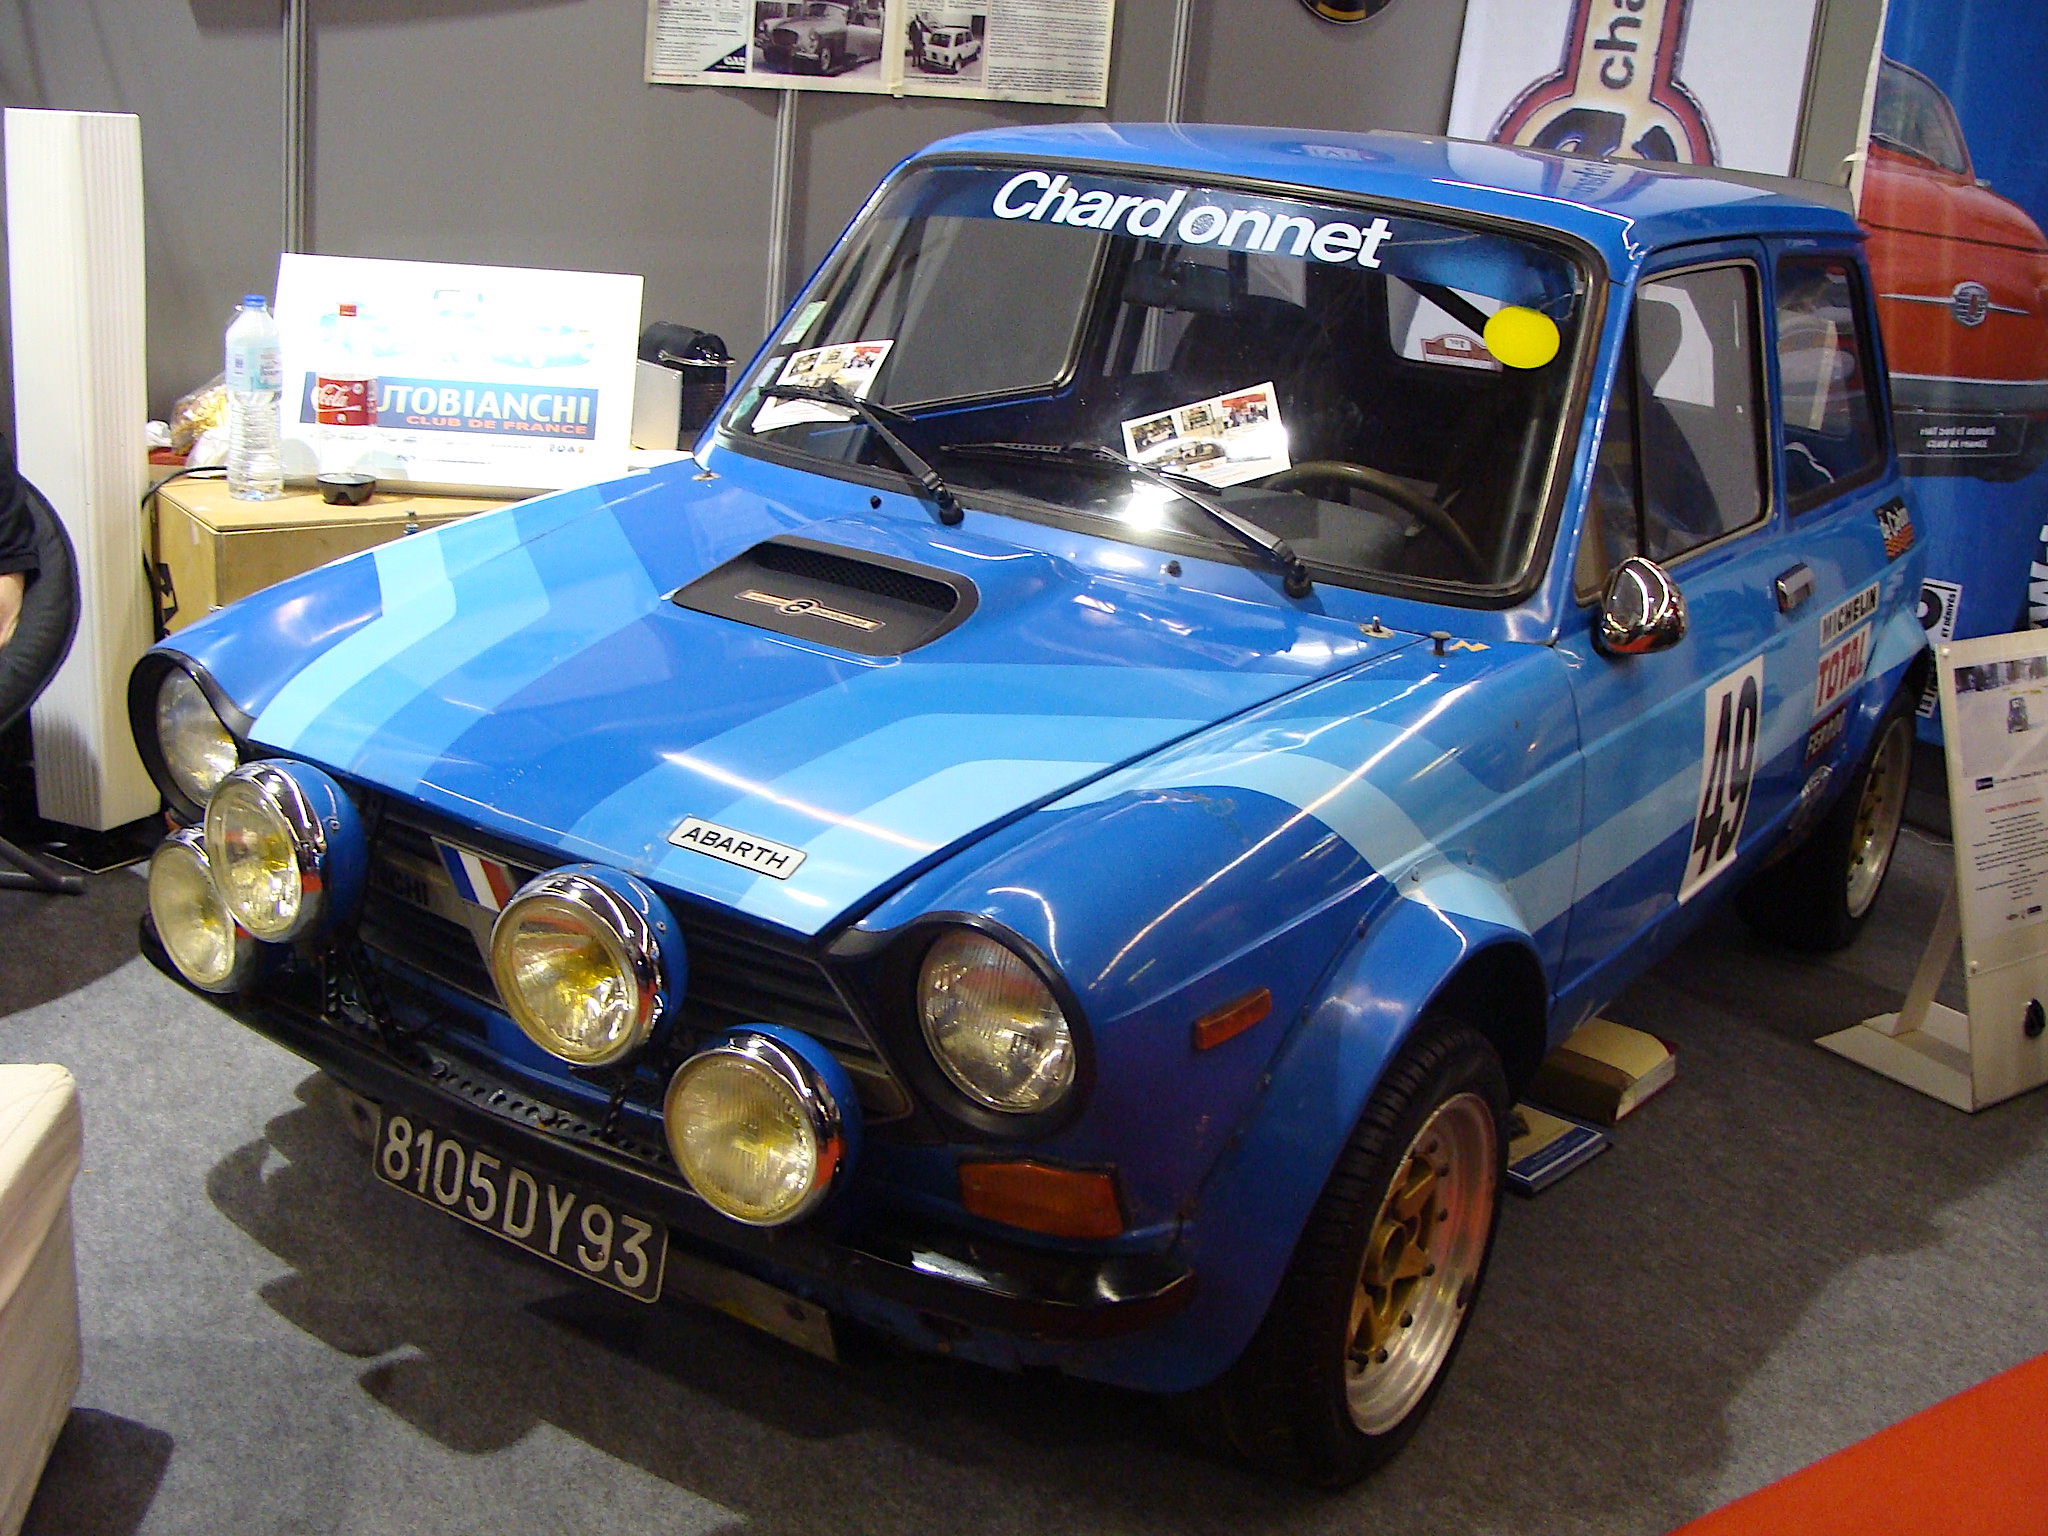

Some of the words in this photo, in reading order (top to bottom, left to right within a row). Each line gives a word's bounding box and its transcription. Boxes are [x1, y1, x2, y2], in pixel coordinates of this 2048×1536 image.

[992, 170, 1393, 270] Chardonnet
[376, 384, 590, 424] UTOBIANCHI
[405, 415, 462, 428] CLUB
[467, 418, 497, 430] DE
[502, 420, 588, 435] FRANCE
[1821, 584, 1878, 647] MICHELIN
[1817, 630, 1867, 709] TOTAL
[1692, 675, 1758, 877] 49
[680, 826, 790, 870] ABARTH
[382, 1115, 653, 1288] 8105DY93
